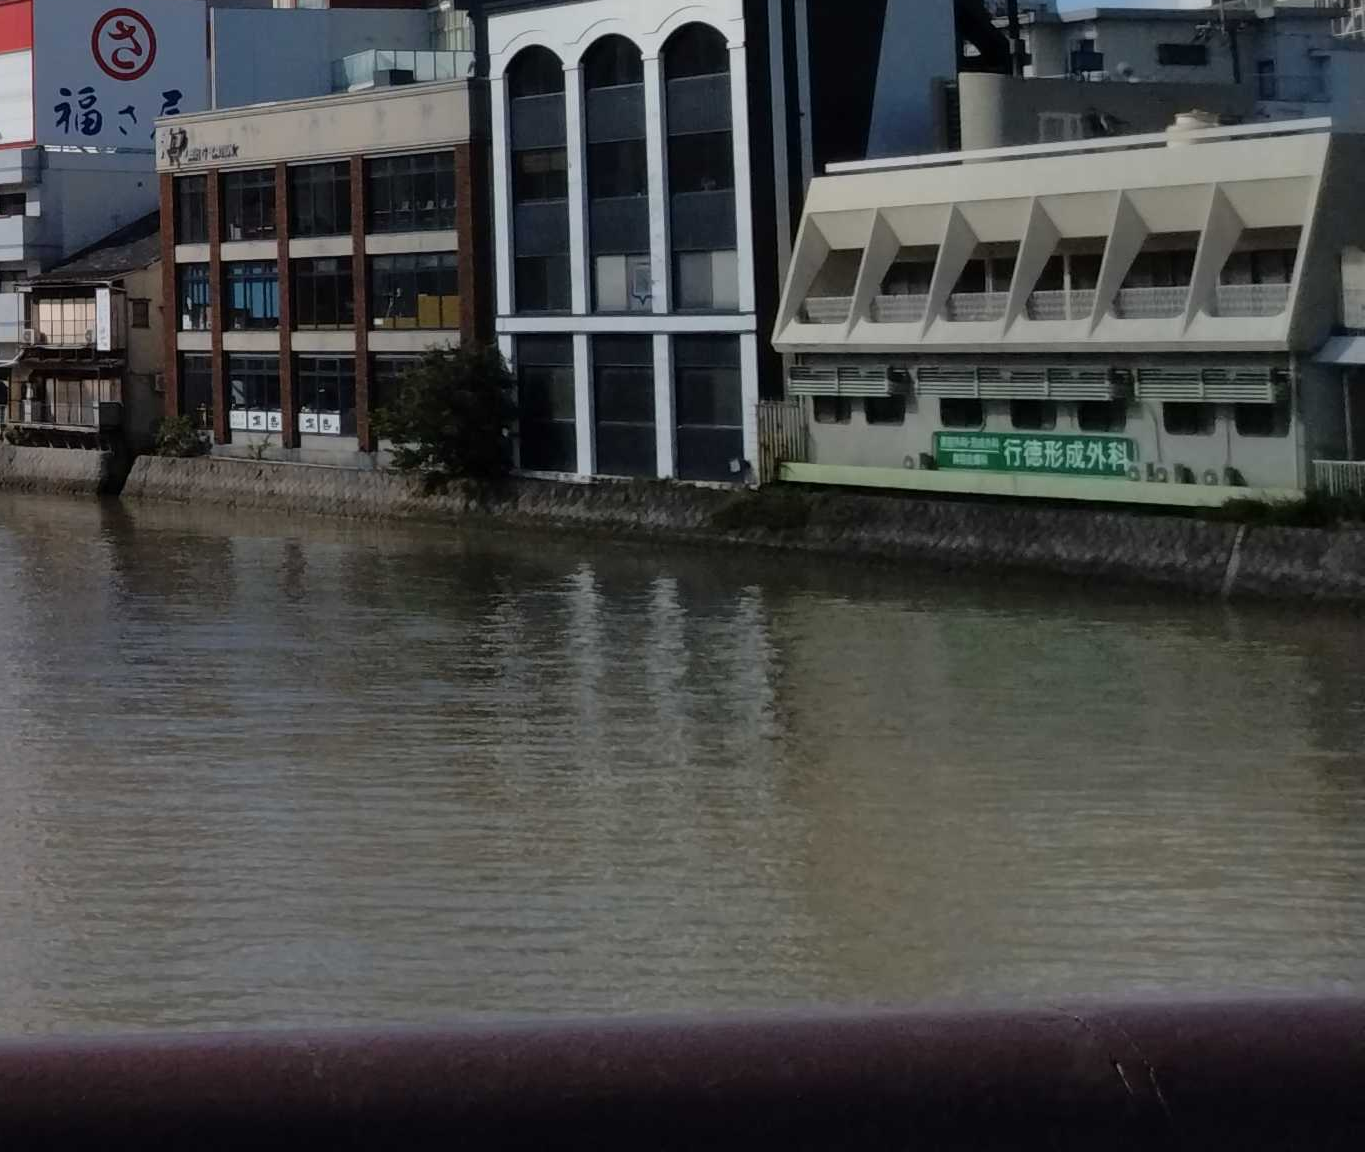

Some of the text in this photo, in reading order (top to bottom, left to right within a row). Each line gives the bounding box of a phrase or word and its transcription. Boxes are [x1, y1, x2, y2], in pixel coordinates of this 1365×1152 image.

[1003, 438, 1130, 471] 行徳形成外科
